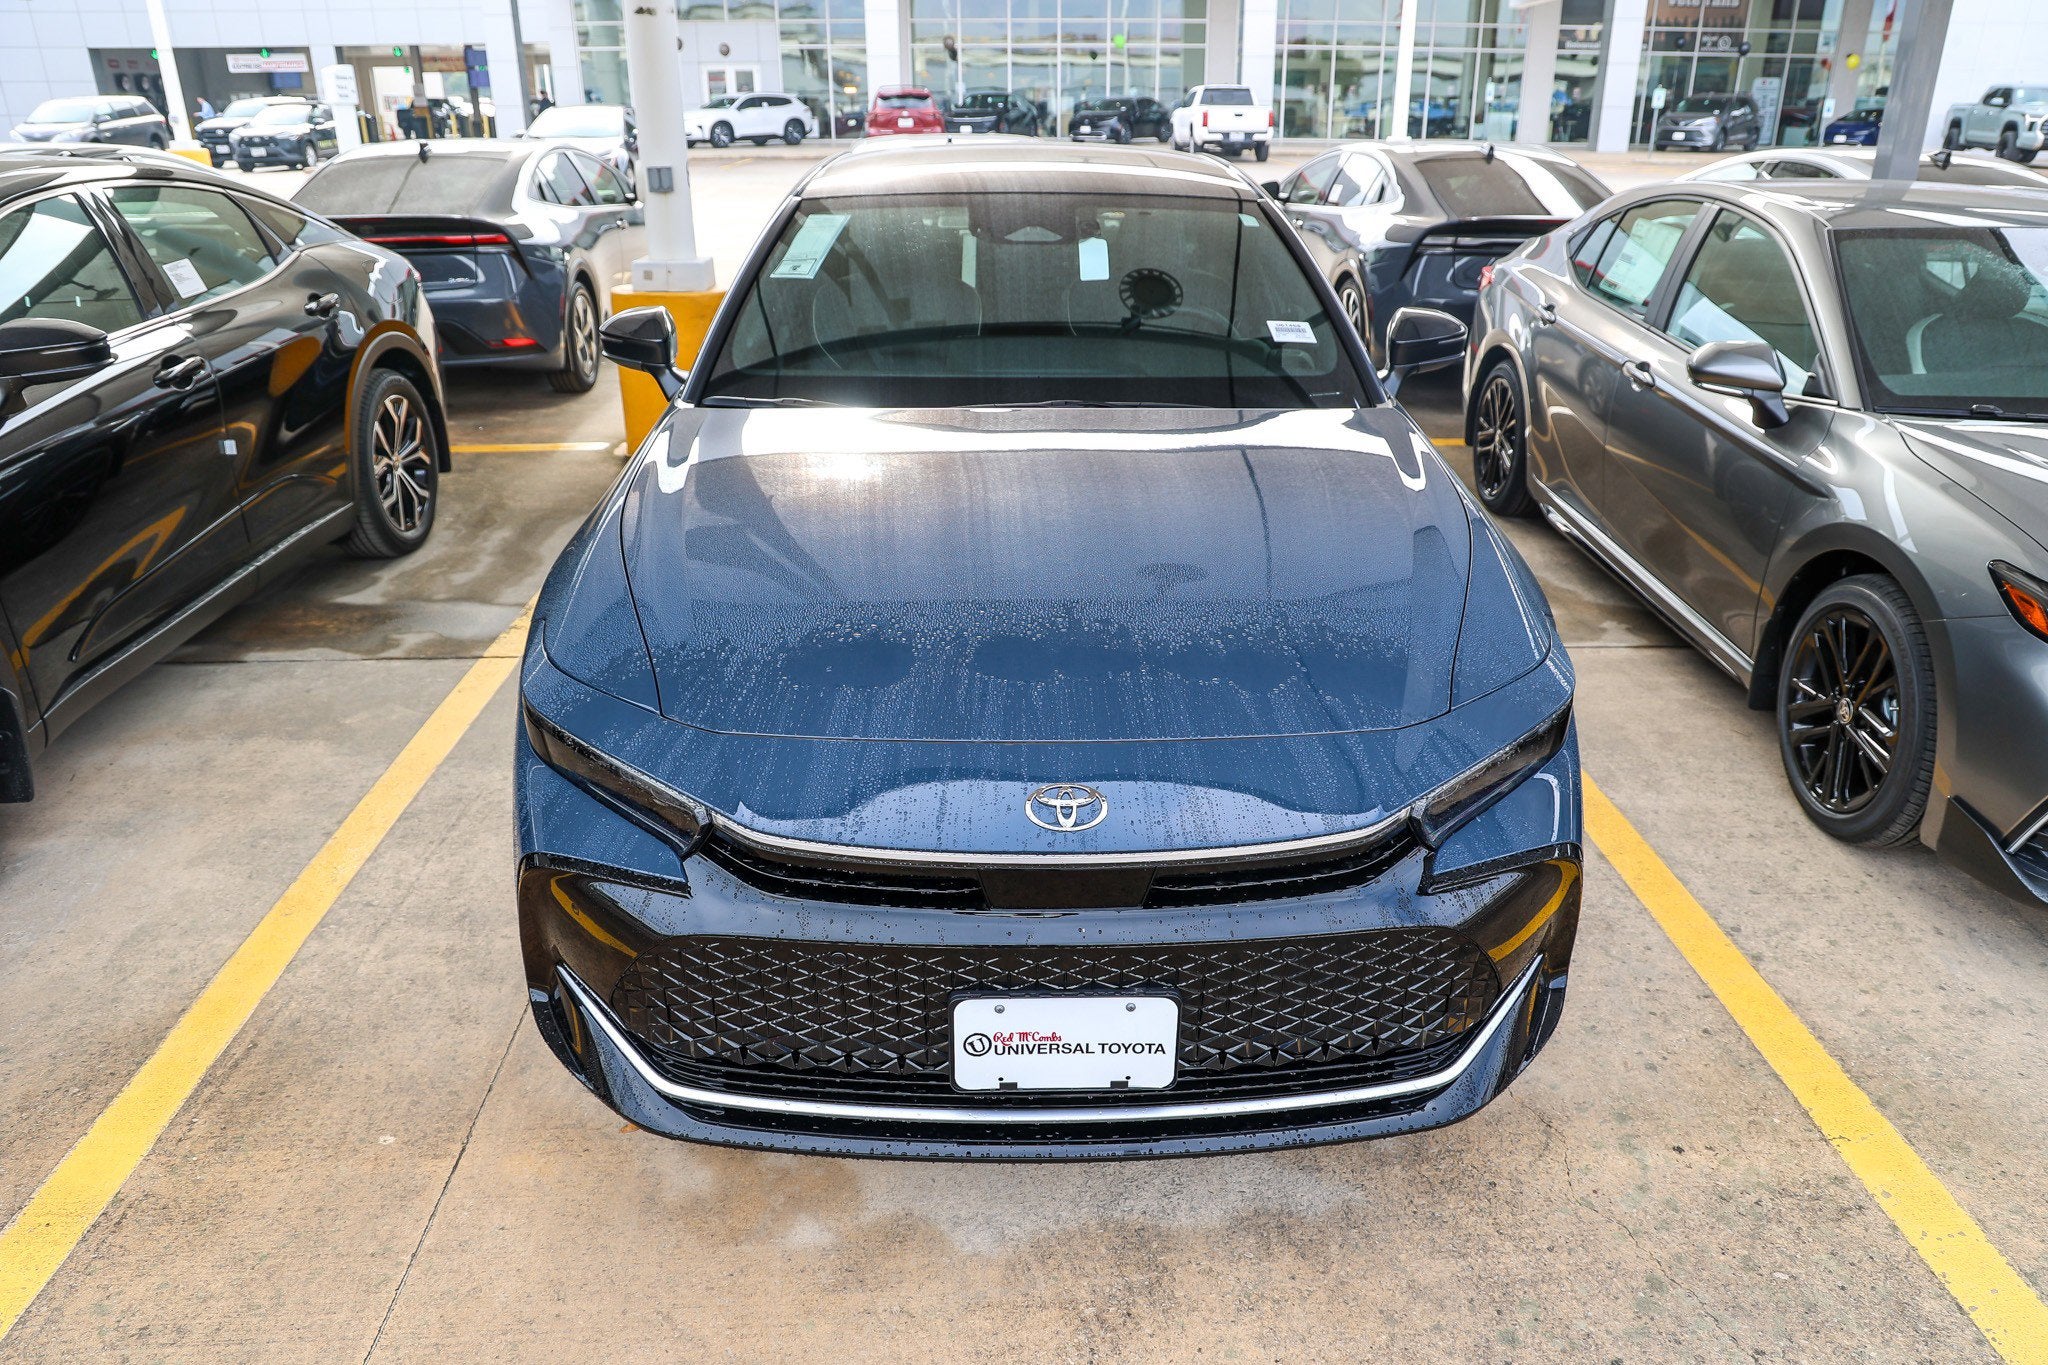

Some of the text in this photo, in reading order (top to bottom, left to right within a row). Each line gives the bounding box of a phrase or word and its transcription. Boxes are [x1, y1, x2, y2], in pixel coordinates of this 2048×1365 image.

[993, 1031, 1062, 1046] Red McCombs
[994, 1043, 1167, 1056] UNIVERSAL TOYOTA
